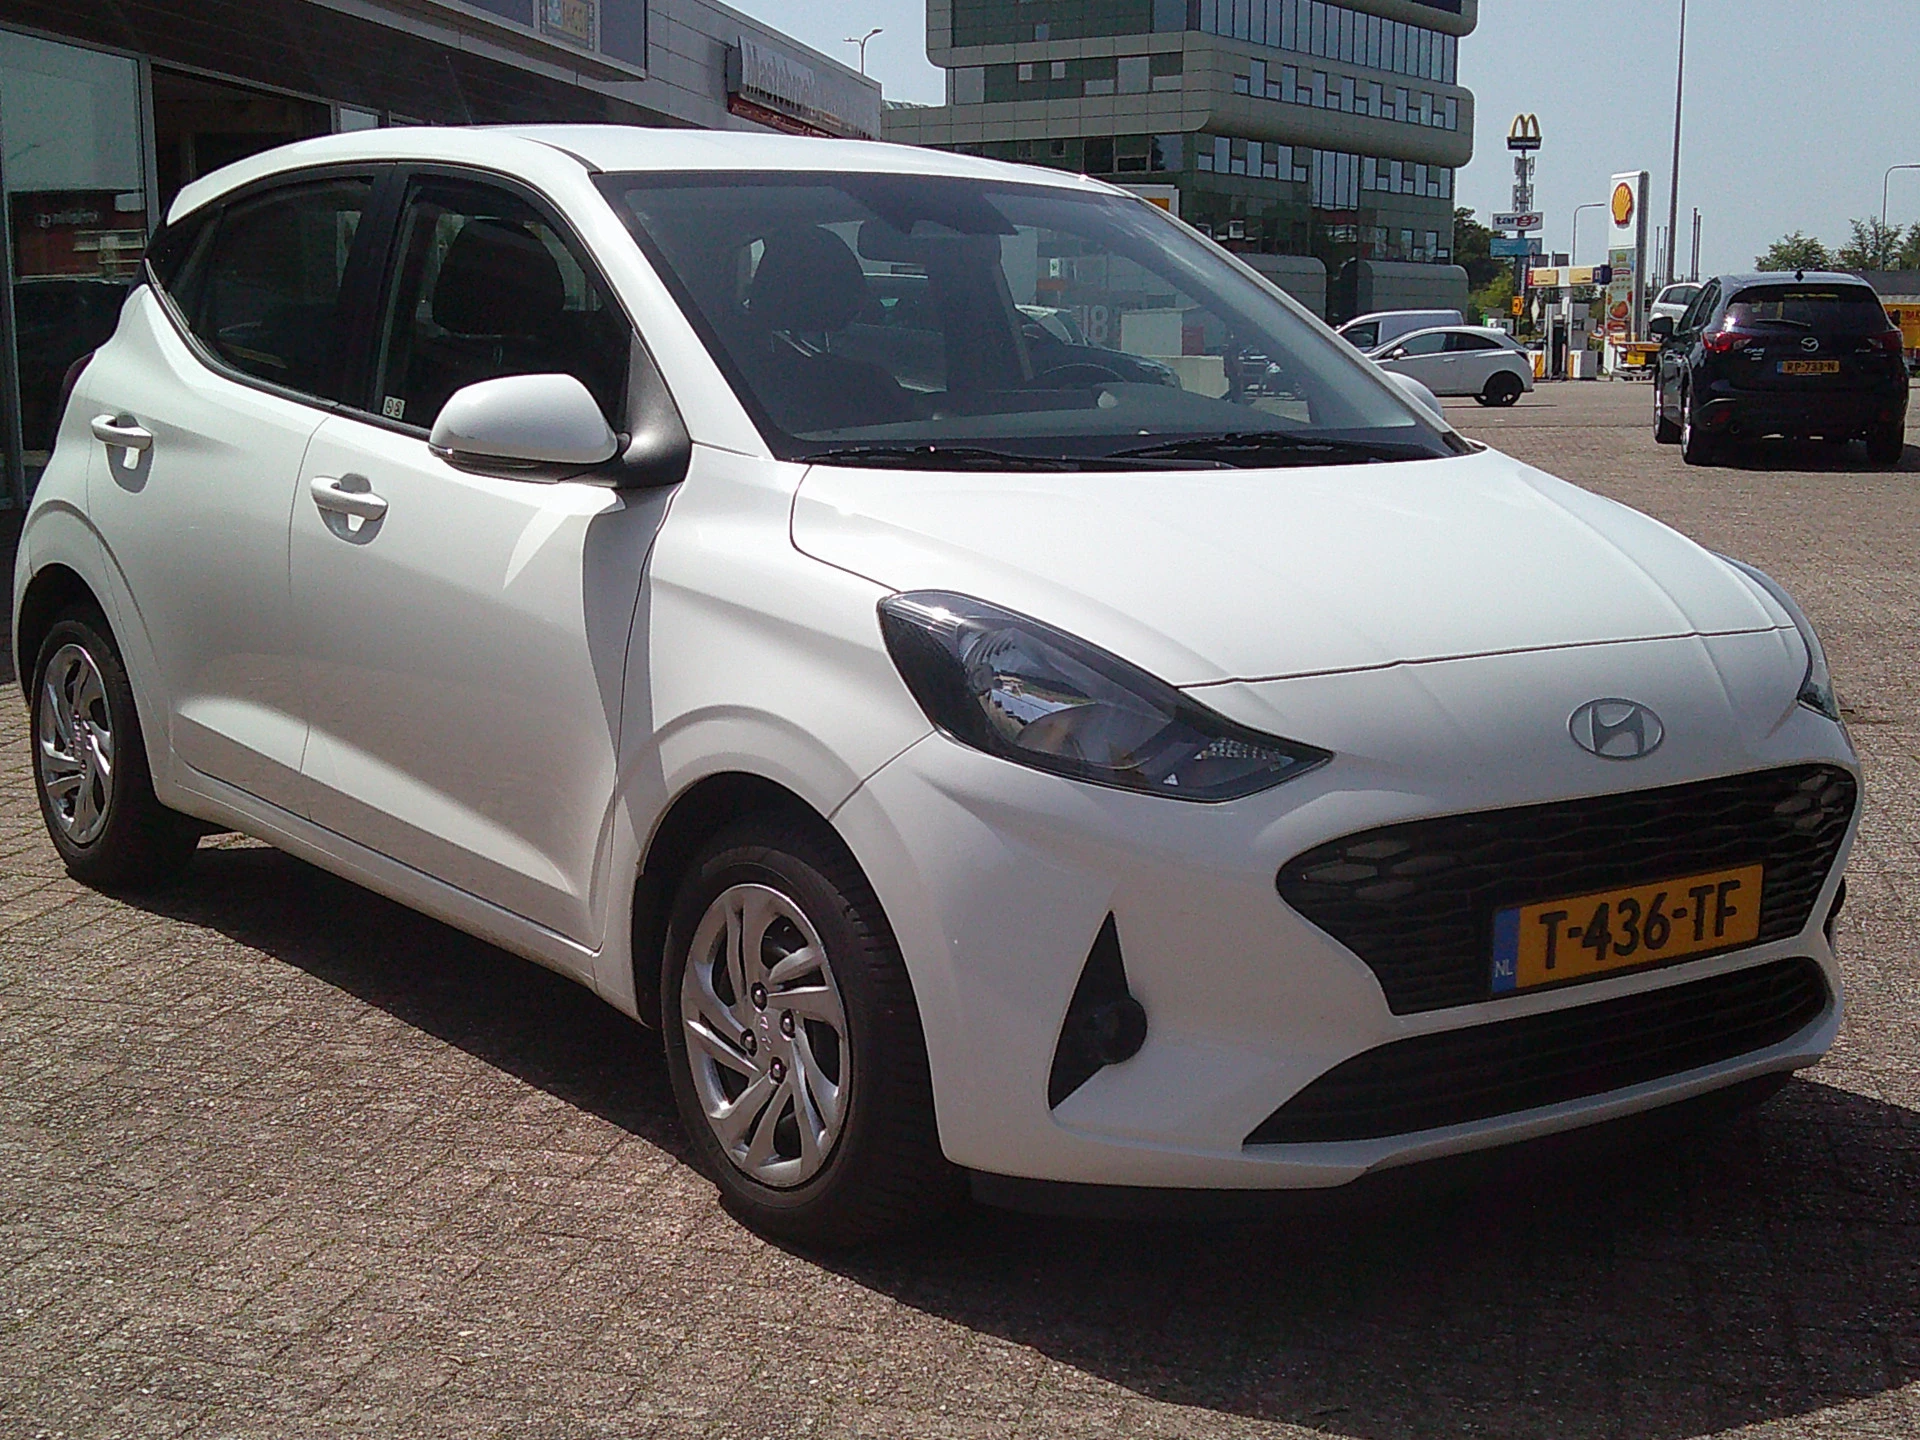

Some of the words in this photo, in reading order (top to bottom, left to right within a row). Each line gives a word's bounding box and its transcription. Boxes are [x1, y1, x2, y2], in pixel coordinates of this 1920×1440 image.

[1495, 215, 1540, 227] tango
[1539, 879, 1741, 969] T-436-TF
[1494, 959, 1514, 979] NL
